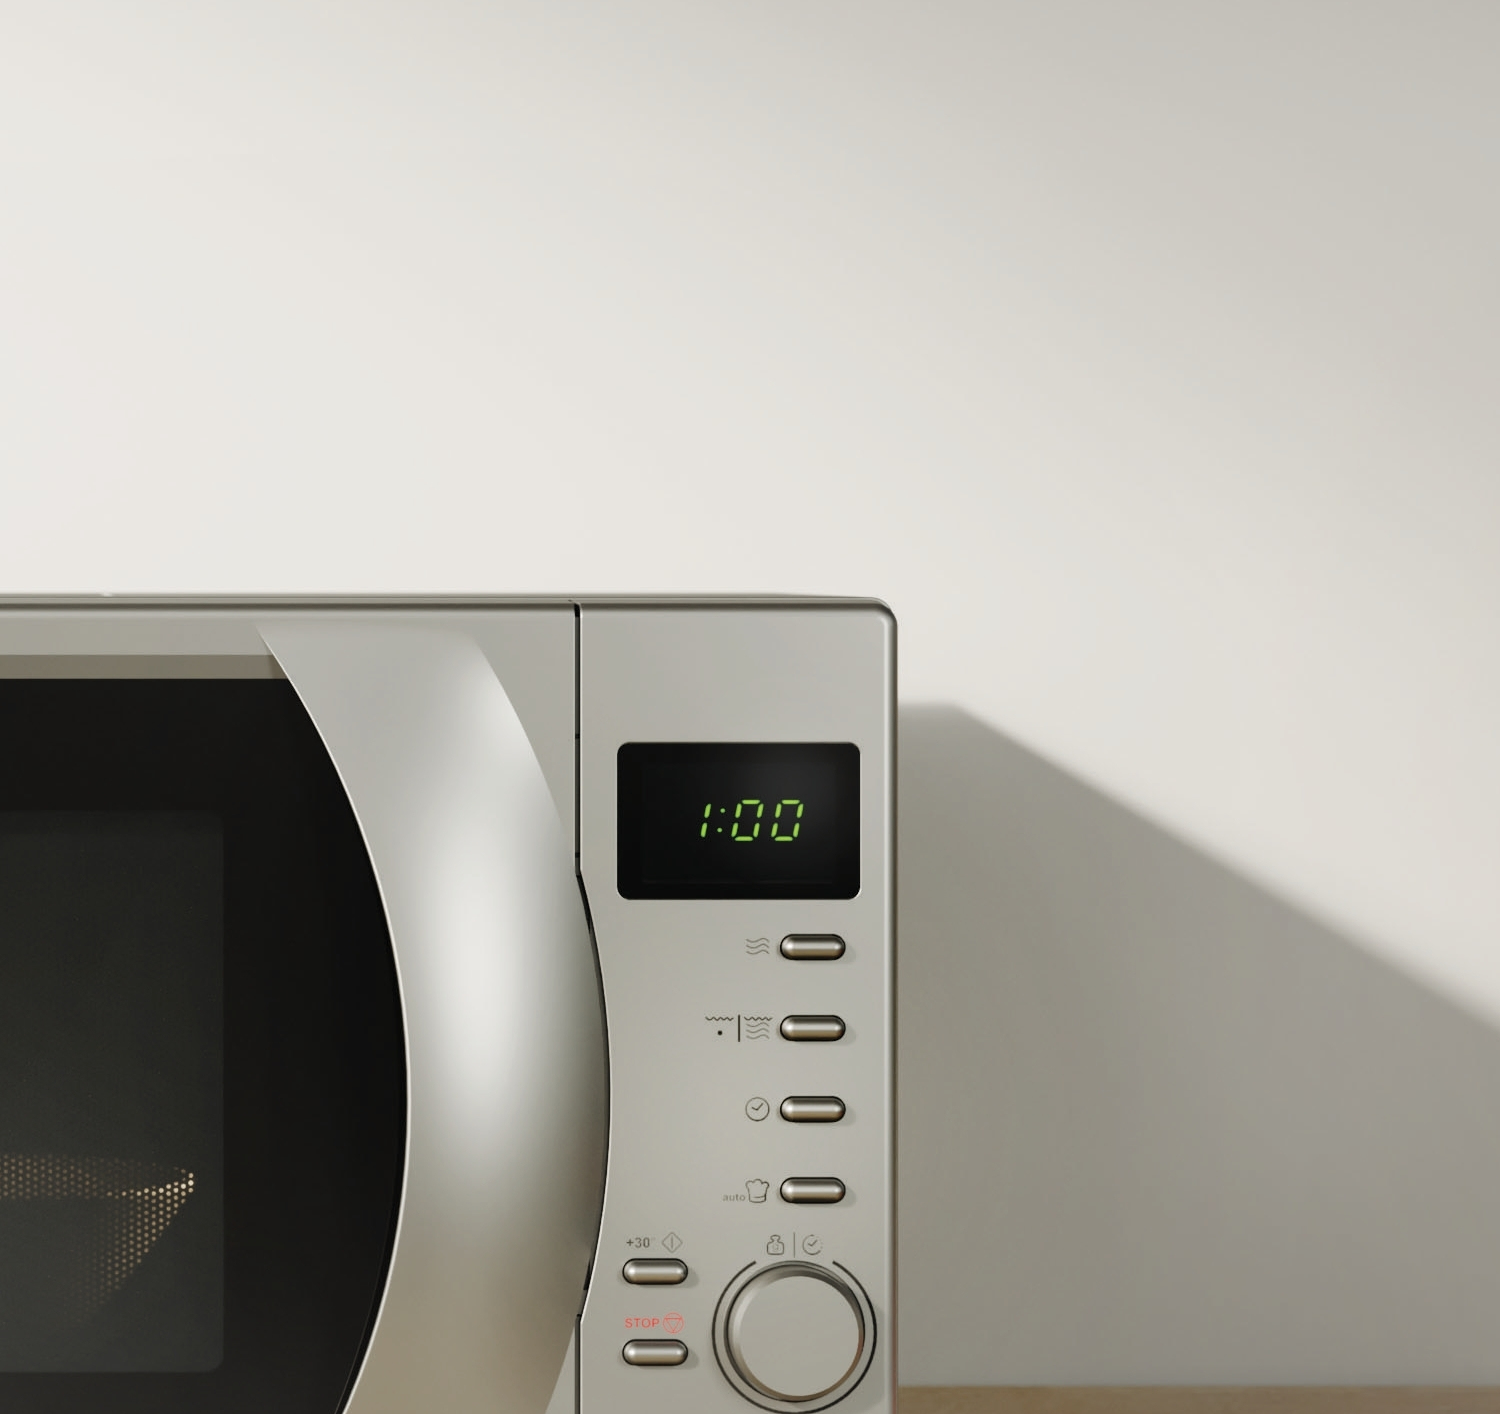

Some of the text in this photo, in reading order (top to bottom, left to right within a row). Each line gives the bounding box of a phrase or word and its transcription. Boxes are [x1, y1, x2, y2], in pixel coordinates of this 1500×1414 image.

[700, 799, 804, 842] 1:00
[722, 1193, 746, 1202] auto
[624, 1317, 660, 1329] STOP
